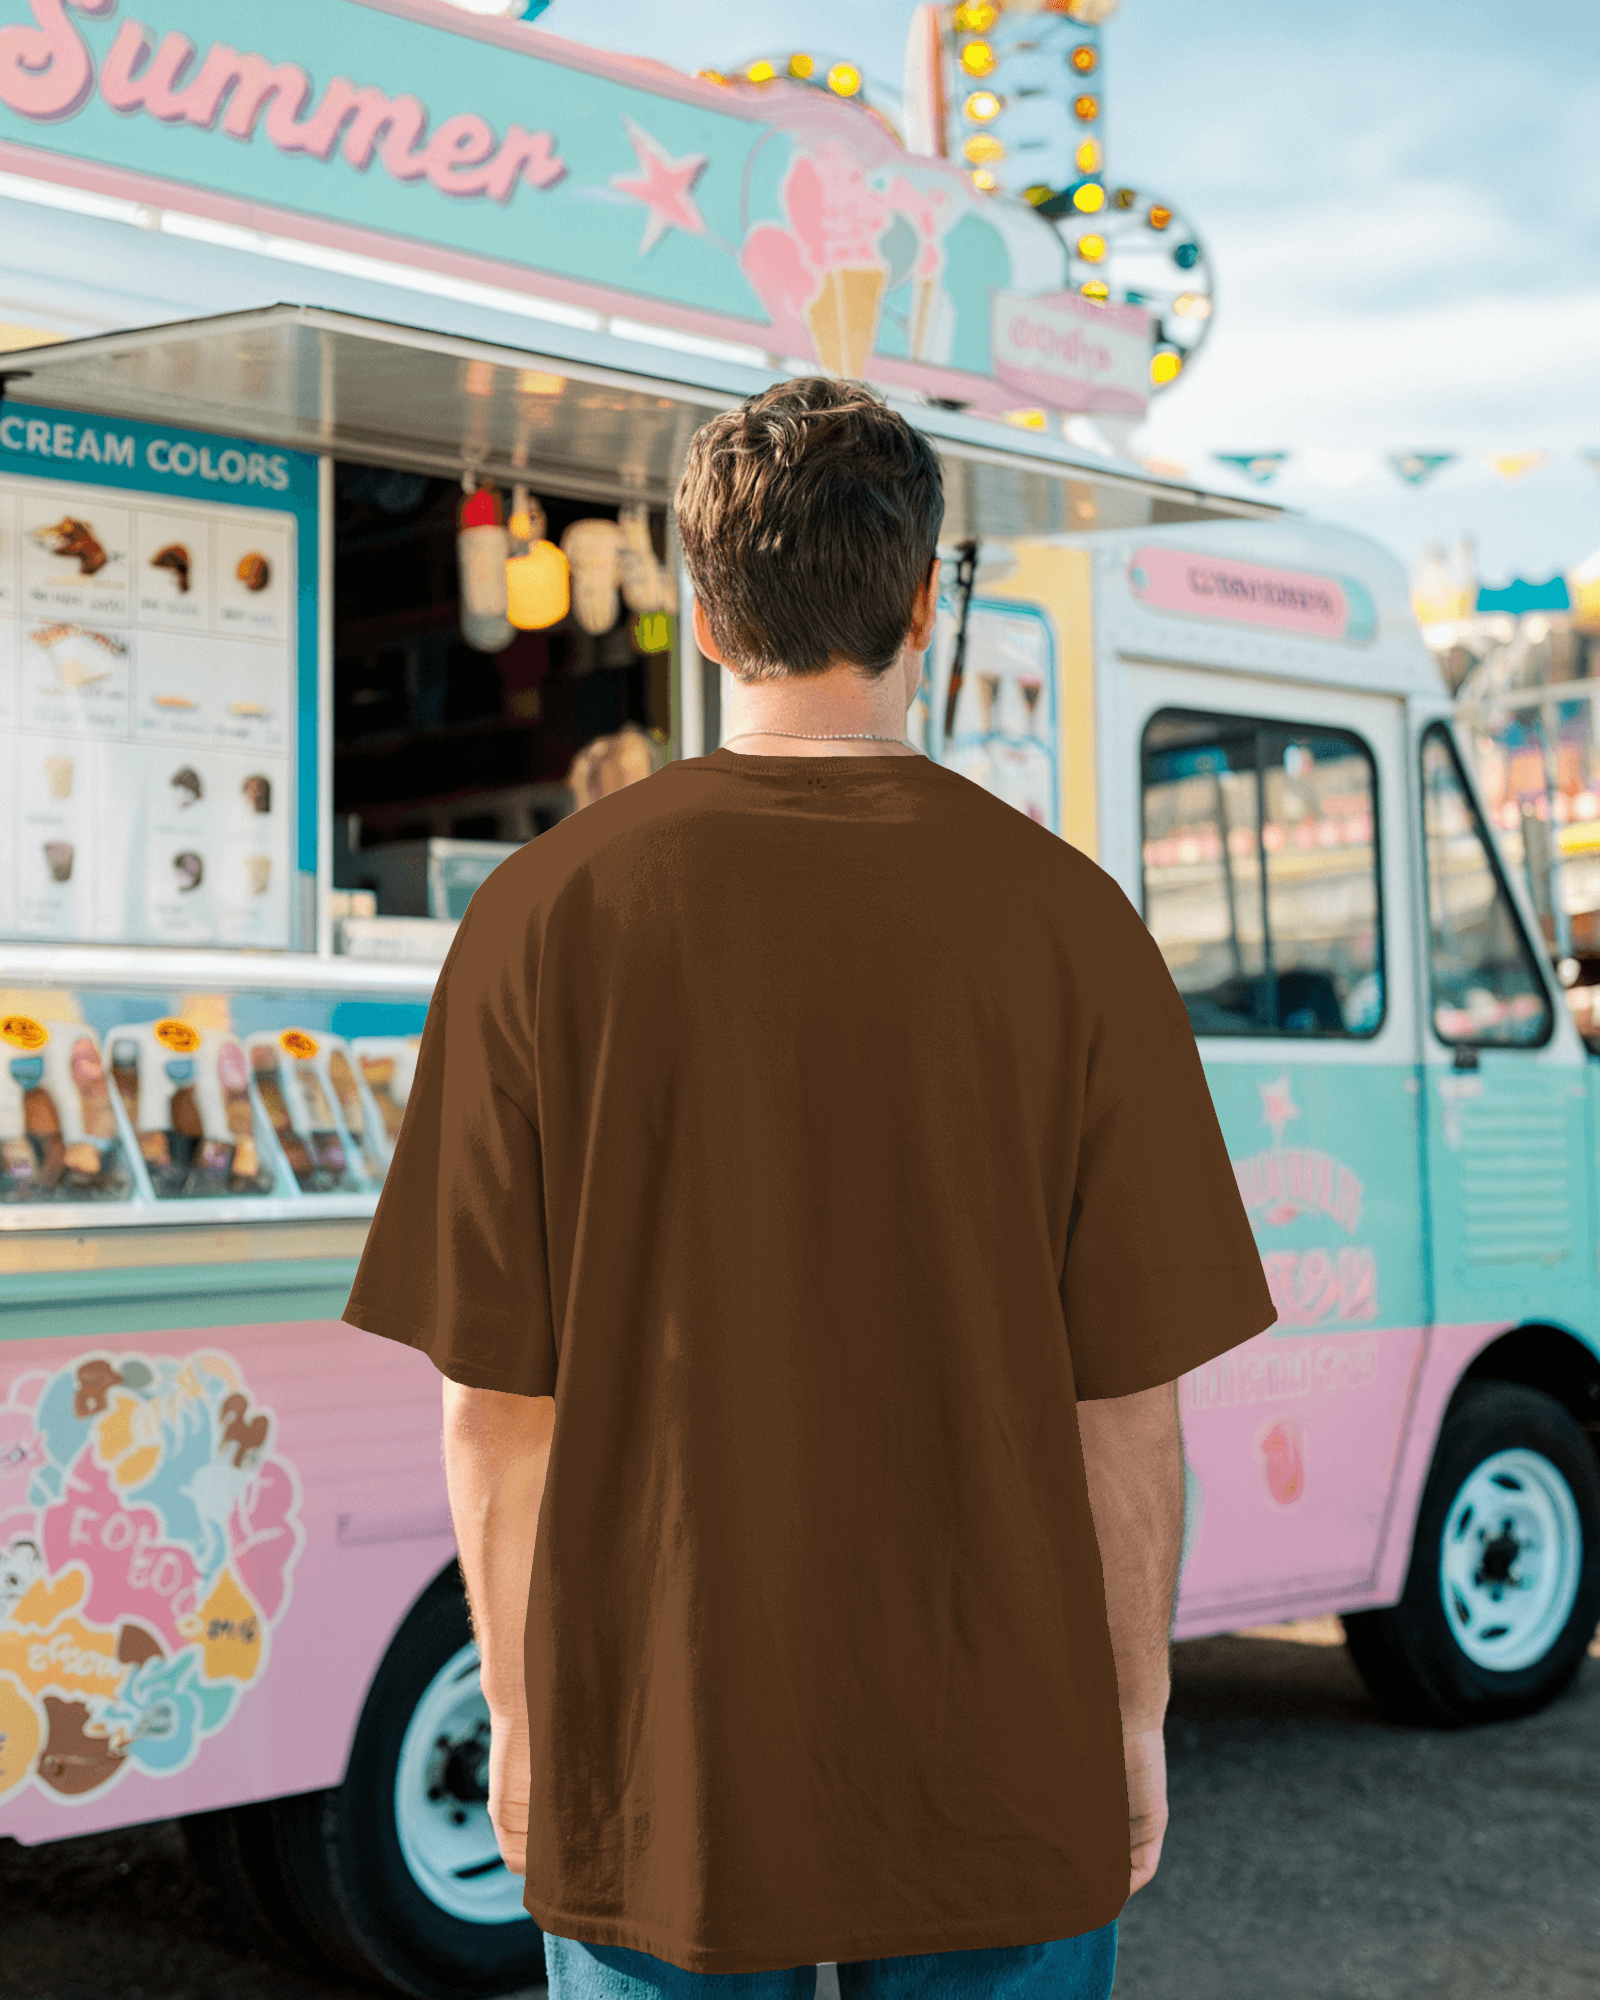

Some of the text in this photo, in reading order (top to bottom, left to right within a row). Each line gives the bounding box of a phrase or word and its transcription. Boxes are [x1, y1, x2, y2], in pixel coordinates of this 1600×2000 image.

[0, 0, 566, 204] Summer
[0, 415, 290, 491] CREAM COLORS
